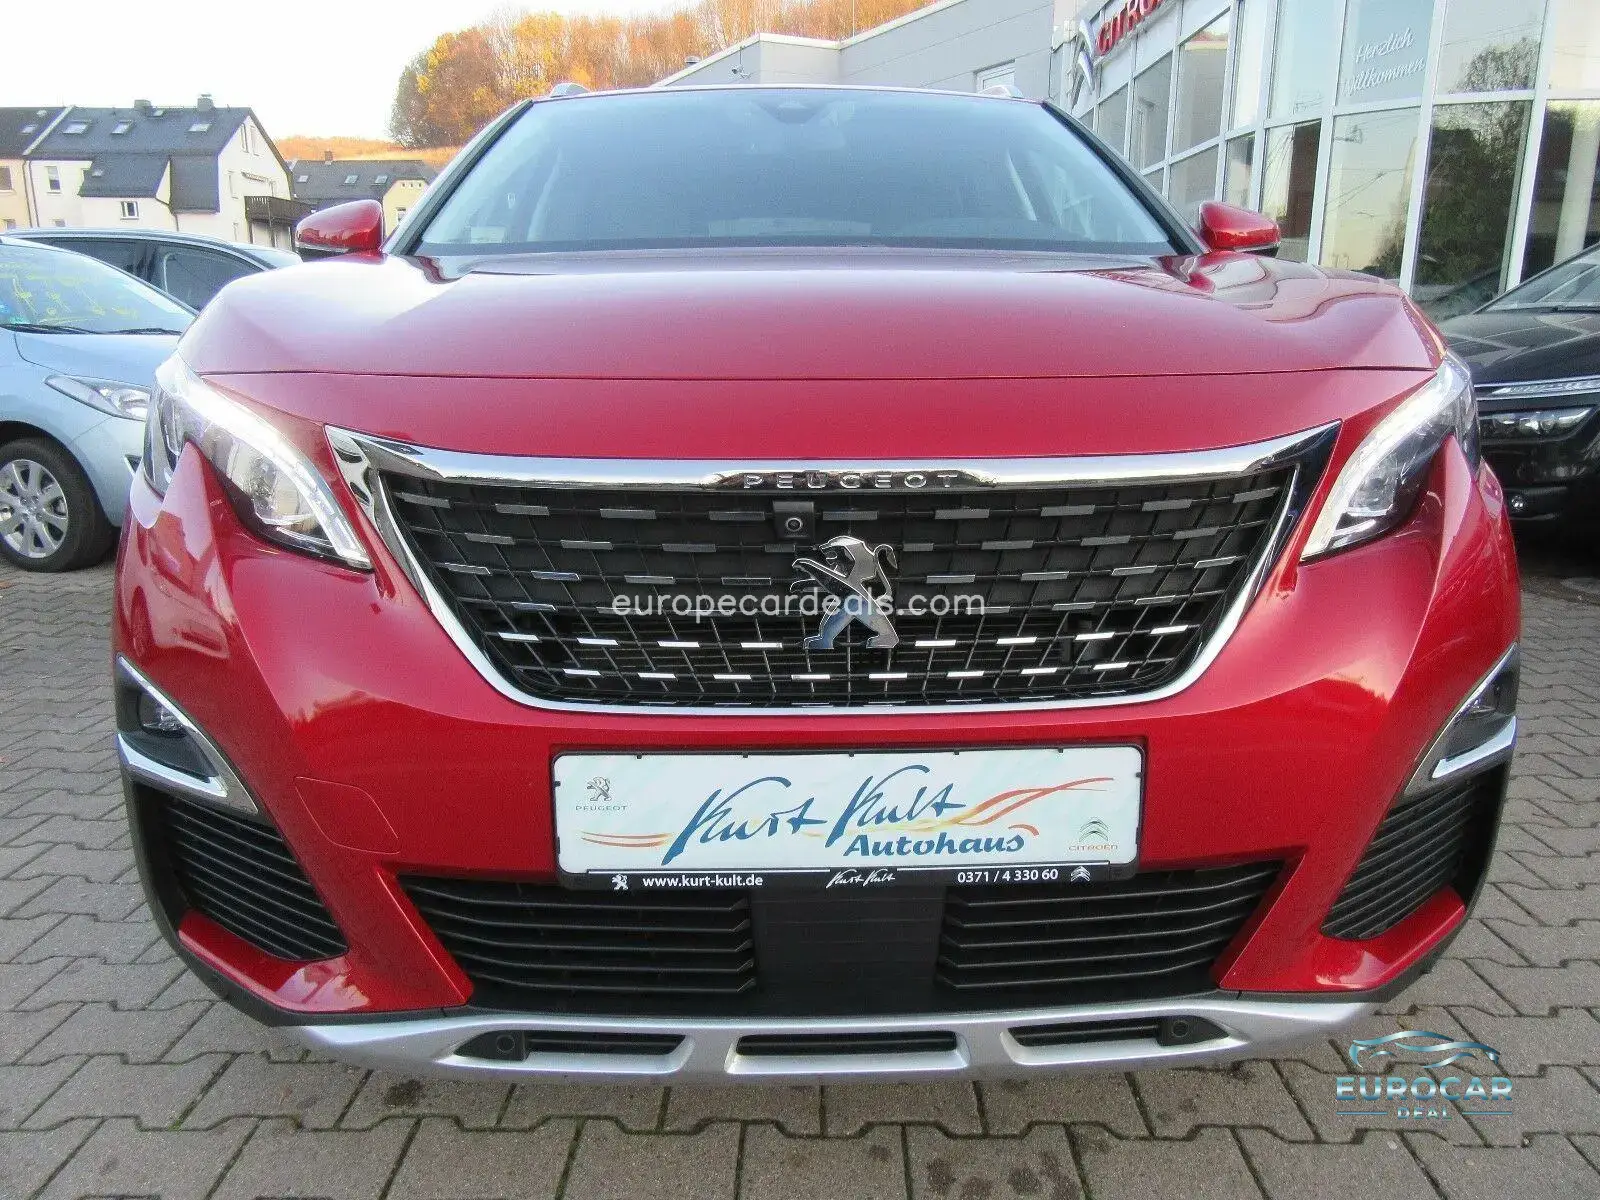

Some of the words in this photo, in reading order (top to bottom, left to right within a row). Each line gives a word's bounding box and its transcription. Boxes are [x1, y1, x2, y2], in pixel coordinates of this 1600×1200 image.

[1354, 27, 1414, 64] Herzlich
[1341, 57, 1427, 97] Willkommen
[743, 472, 958, 489] PEUGEOT
[574, 804, 629, 812] PEUGEOT
[661, 776, 827, 866] Kurt
[825, 764, 966, 848] Kult
[843, 832, 1025, 857] Autohaus
[642, 874, 763, 888] www.kurt-kult.de
[825, 868, 864, 888] Kurt
[862, 868, 896, 887] Kult
[957, 871, 989, 883] 0371
[993, 870, 1000, 883] /
[1002, 870, 1011, 881] 4
[1014, 869, 1039, 881] 330
[1041, 868, 1058, 880] 60
